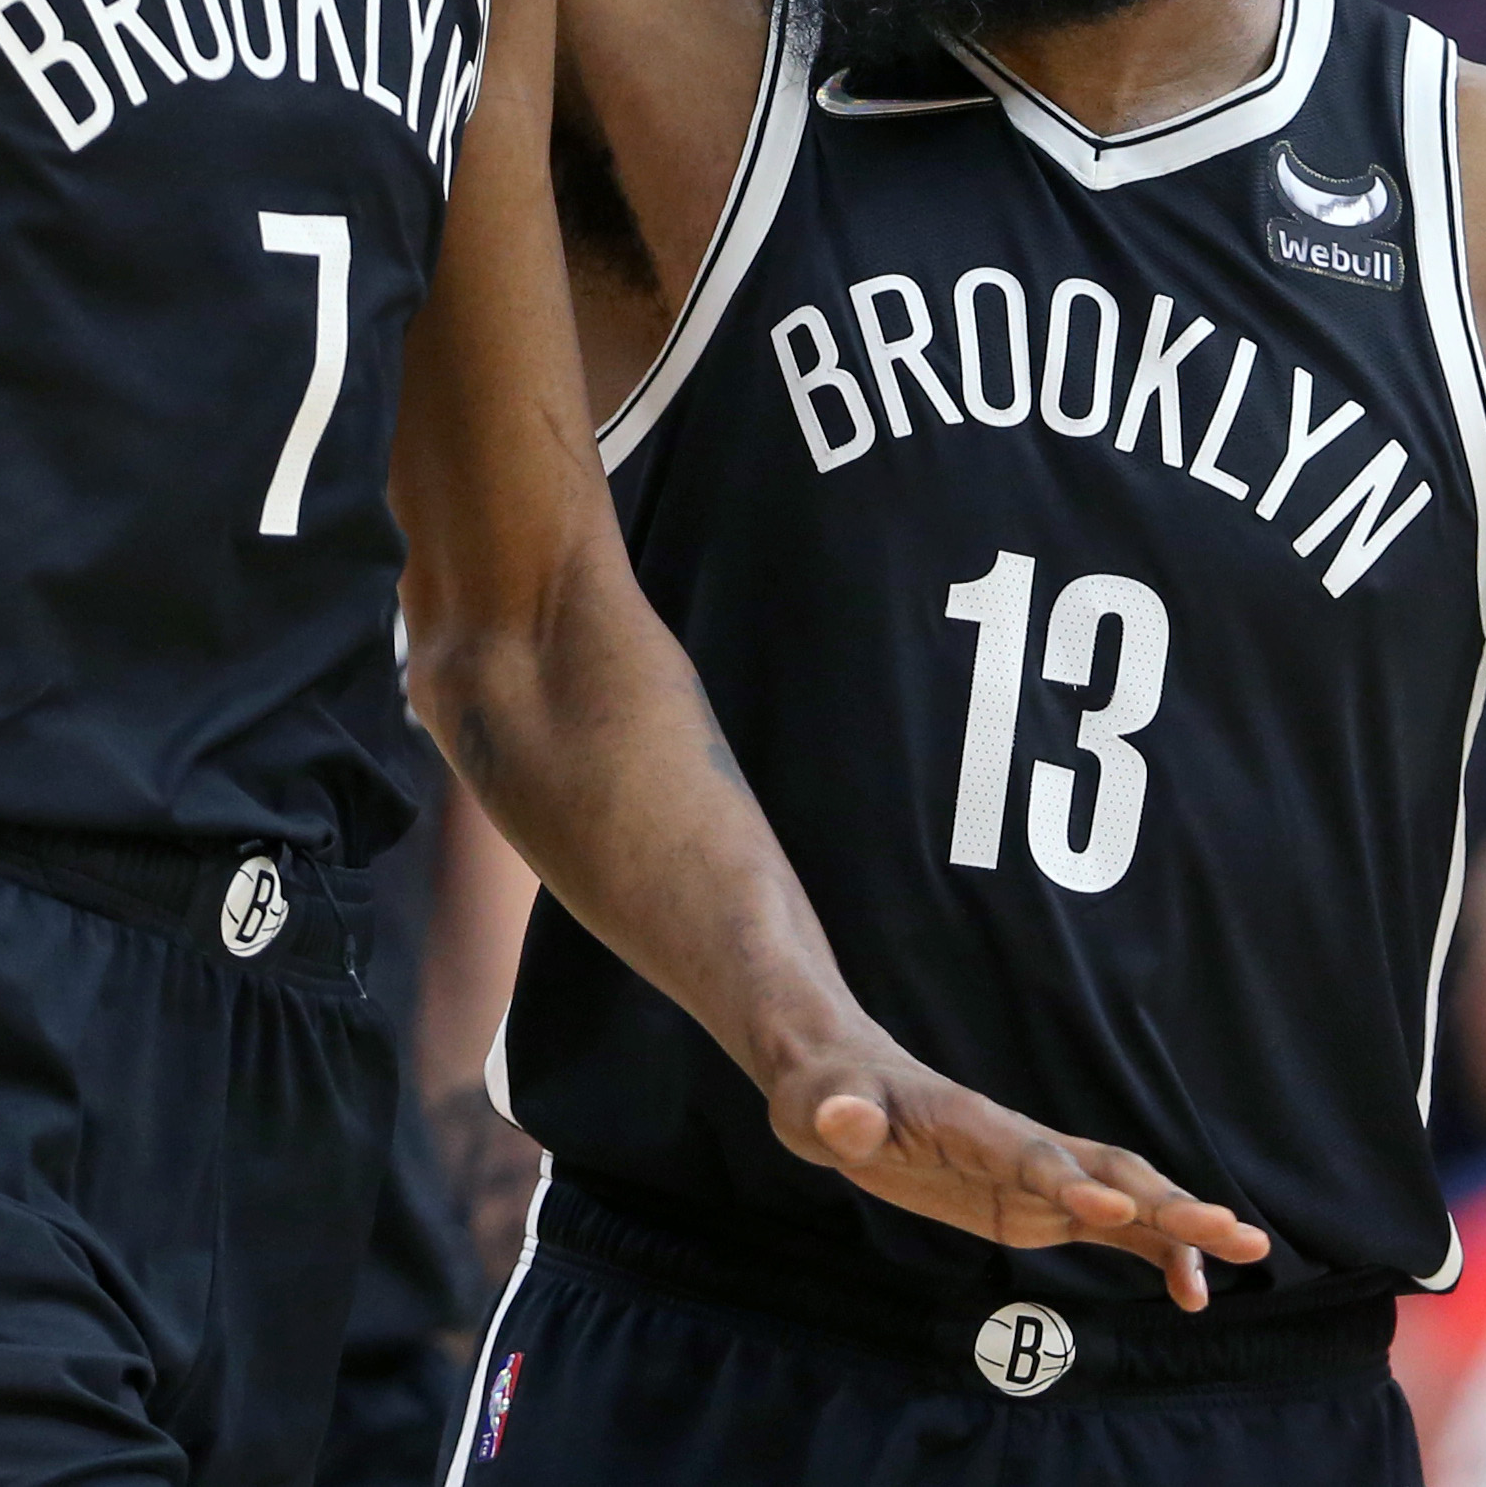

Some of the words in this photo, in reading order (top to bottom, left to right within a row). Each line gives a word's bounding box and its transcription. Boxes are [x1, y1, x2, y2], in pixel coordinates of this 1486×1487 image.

[1278, 230, 1392, 282] Webull
[259, 211, 351, 536] 7
[770, 266, 1433, 598] BROOKLYN
[945, 550, 1170, 894] 13
[236, 870, 274, 943] B
[1006, 1316, 1043, 1384] B
